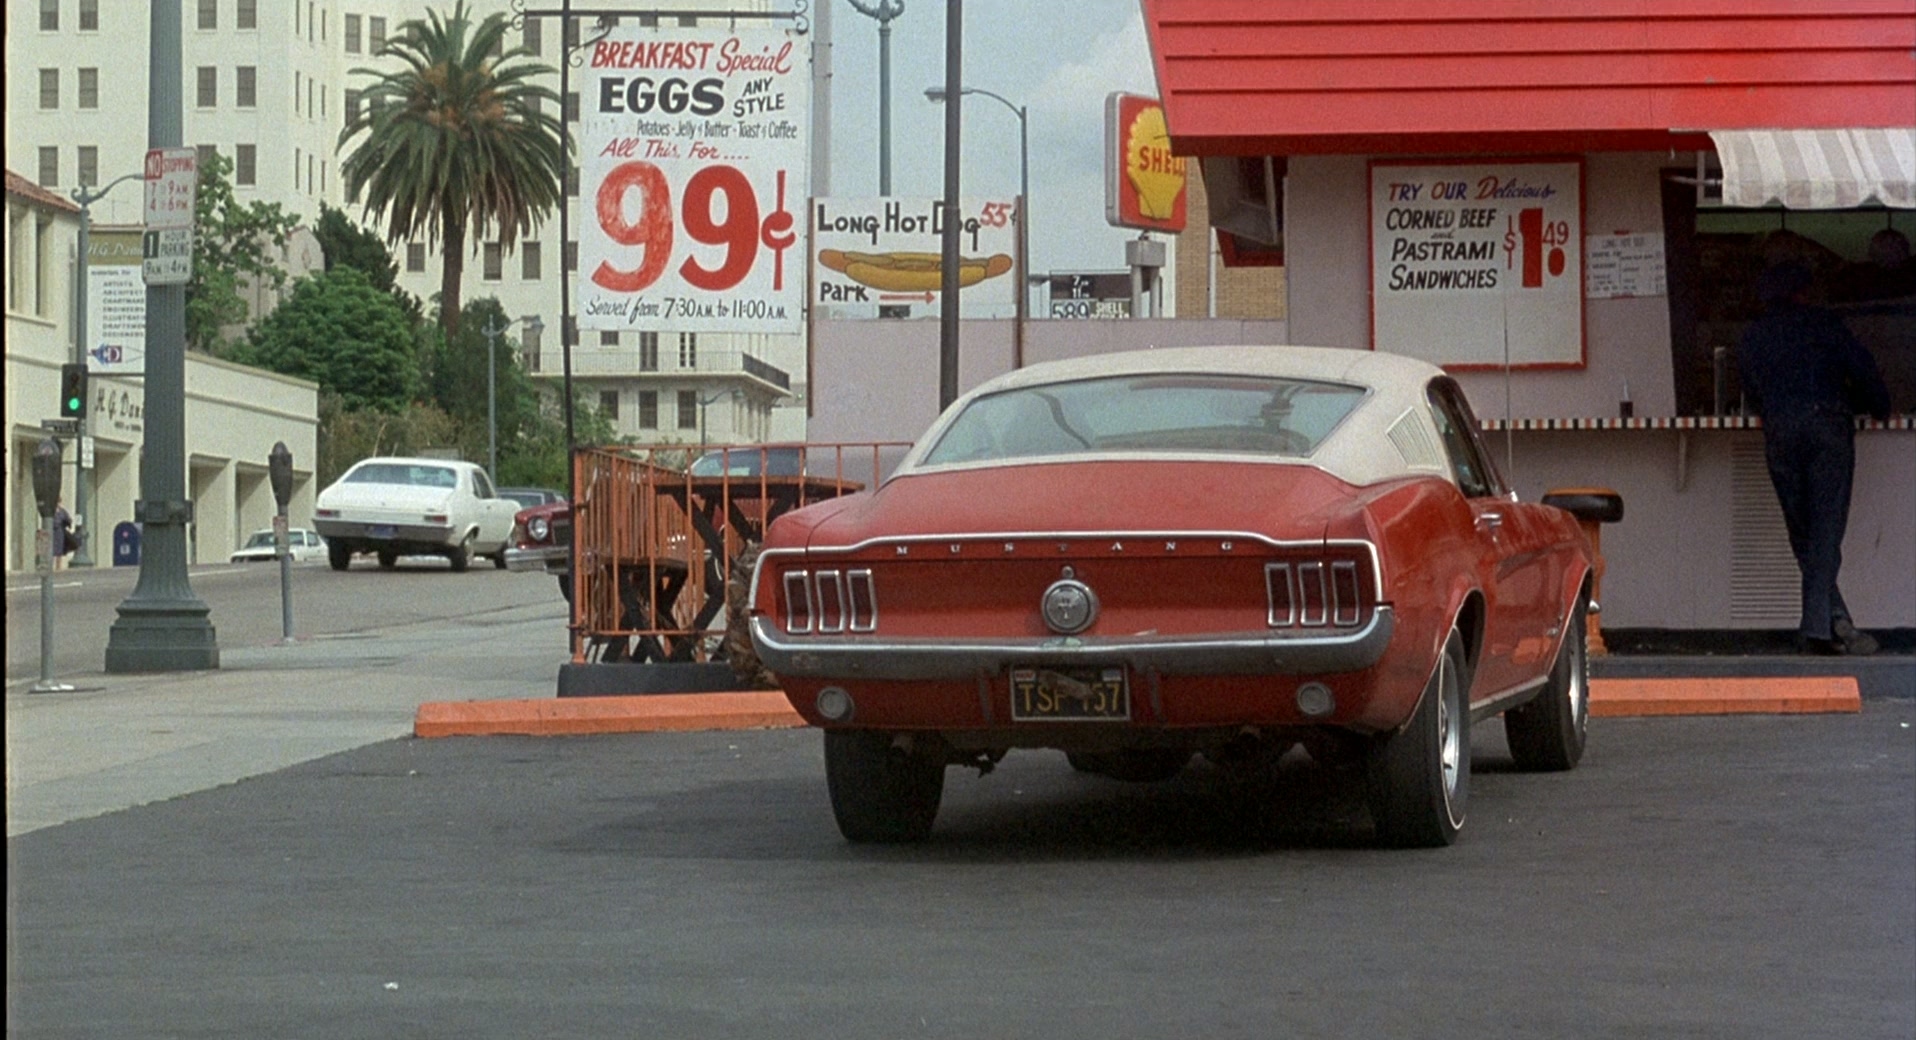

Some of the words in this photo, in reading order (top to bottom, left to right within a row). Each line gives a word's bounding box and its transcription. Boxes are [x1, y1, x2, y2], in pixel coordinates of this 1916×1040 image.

[591, 41, 714, 70] BREAKFAST
[716, 37, 793, 78] Special
[599, 76, 725, 116] EGGS
[742, 77, 774, 97] ANY
[732, 93, 785, 118] STYLE
[768, 120, 798, 139] Coffee
[600, 137, 640, 158] All
[146, 153, 161, 177] NO
[1139, 145, 1186, 176] SHELL
[1389, 183, 1423, 200] TRY
[1431, 181, 1467, 200] OUR
[1474, 176, 1556, 200] Delicious
[885, 202, 928, 233] HOT
[933, 201, 981, 251] DG
[1386, 207, 1454, 231] CORNED
[1459, 208, 1497, 228] BEEF
[1391, 238, 1495, 261] PASTRAMI
[1388, 264, 1498, 291] SANDWICHES
[820, 281, 869, 303] Park
[586, 295, 627, 317] Served
[629, 296, 660, 325] from
[717, 298, 730, 318] to
[896, 542, 1233, 556] MUSTANG
